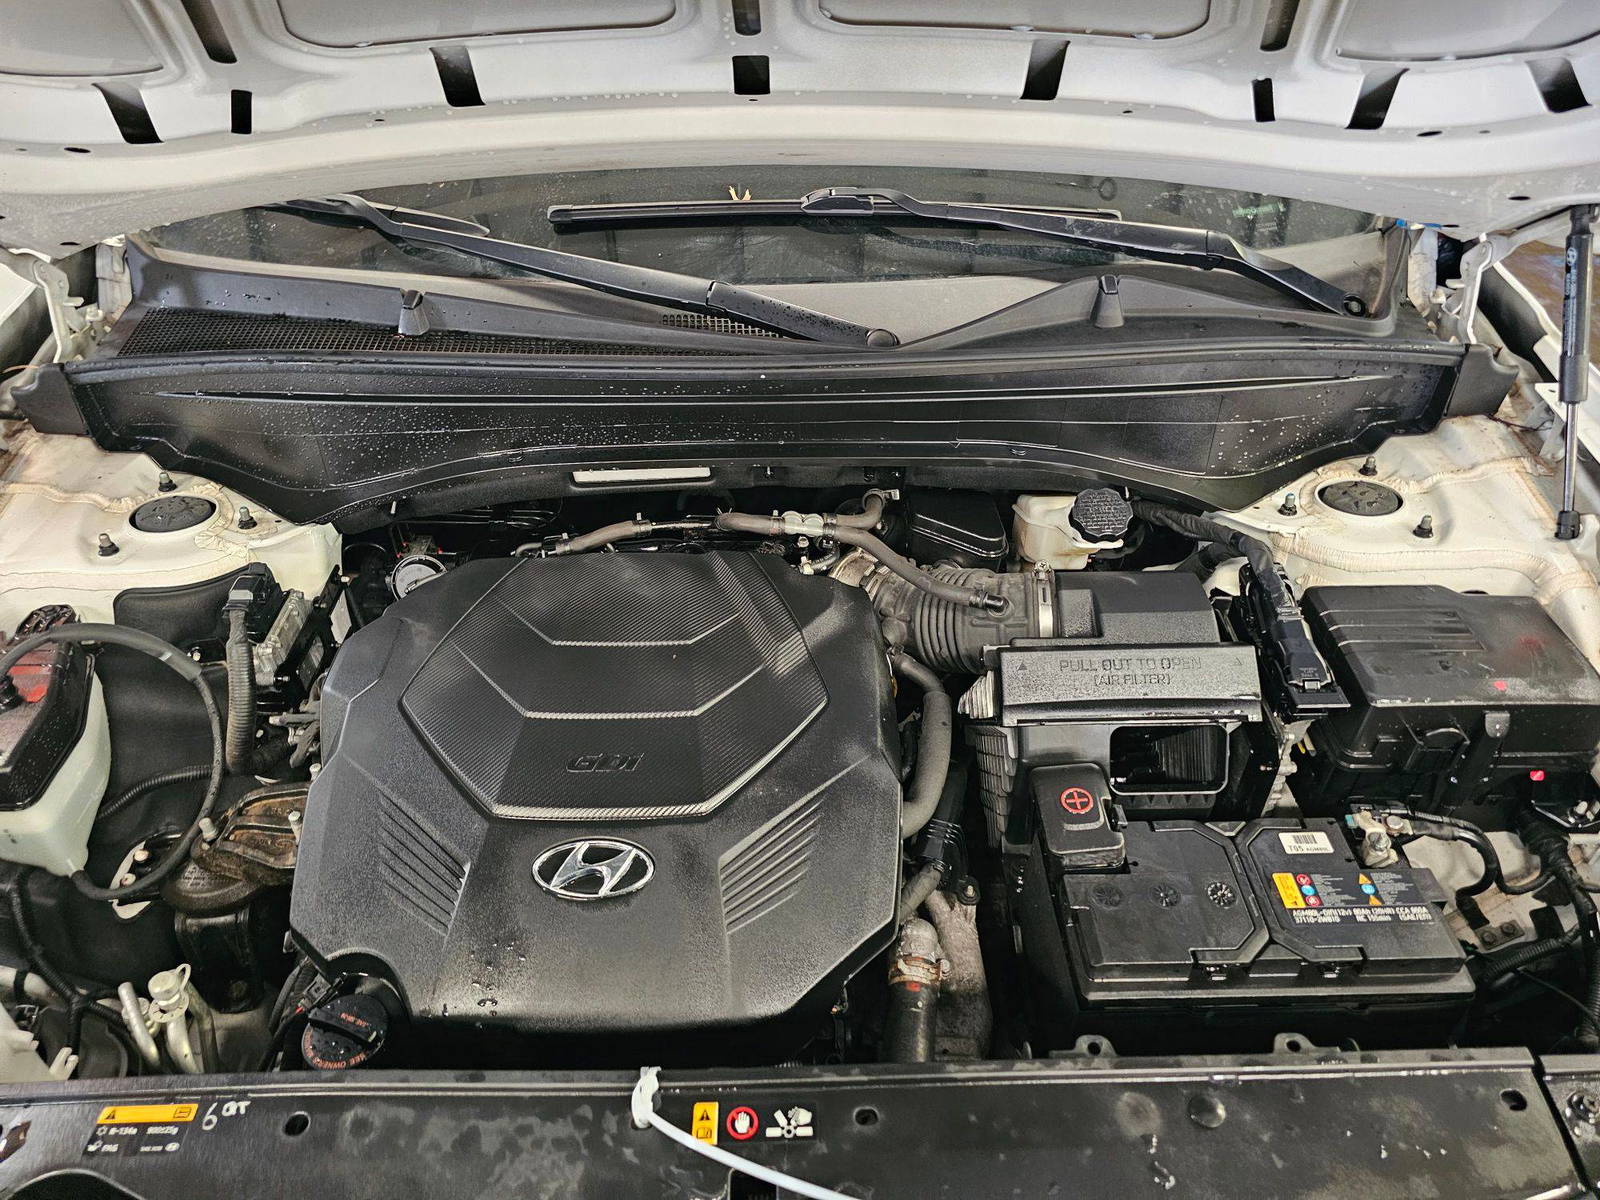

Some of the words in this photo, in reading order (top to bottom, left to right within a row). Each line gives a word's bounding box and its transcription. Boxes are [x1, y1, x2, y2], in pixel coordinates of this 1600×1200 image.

[1059, 659, 1098, 672] PULL
[1101, 658, 1132, 671] OUT
[1136, 657, 1157, 670] TO
[1161, 657, 1202, 670] OPEN
[566, 752, 645, 773] GDI
[201, 1101, 218, 1131] 6
